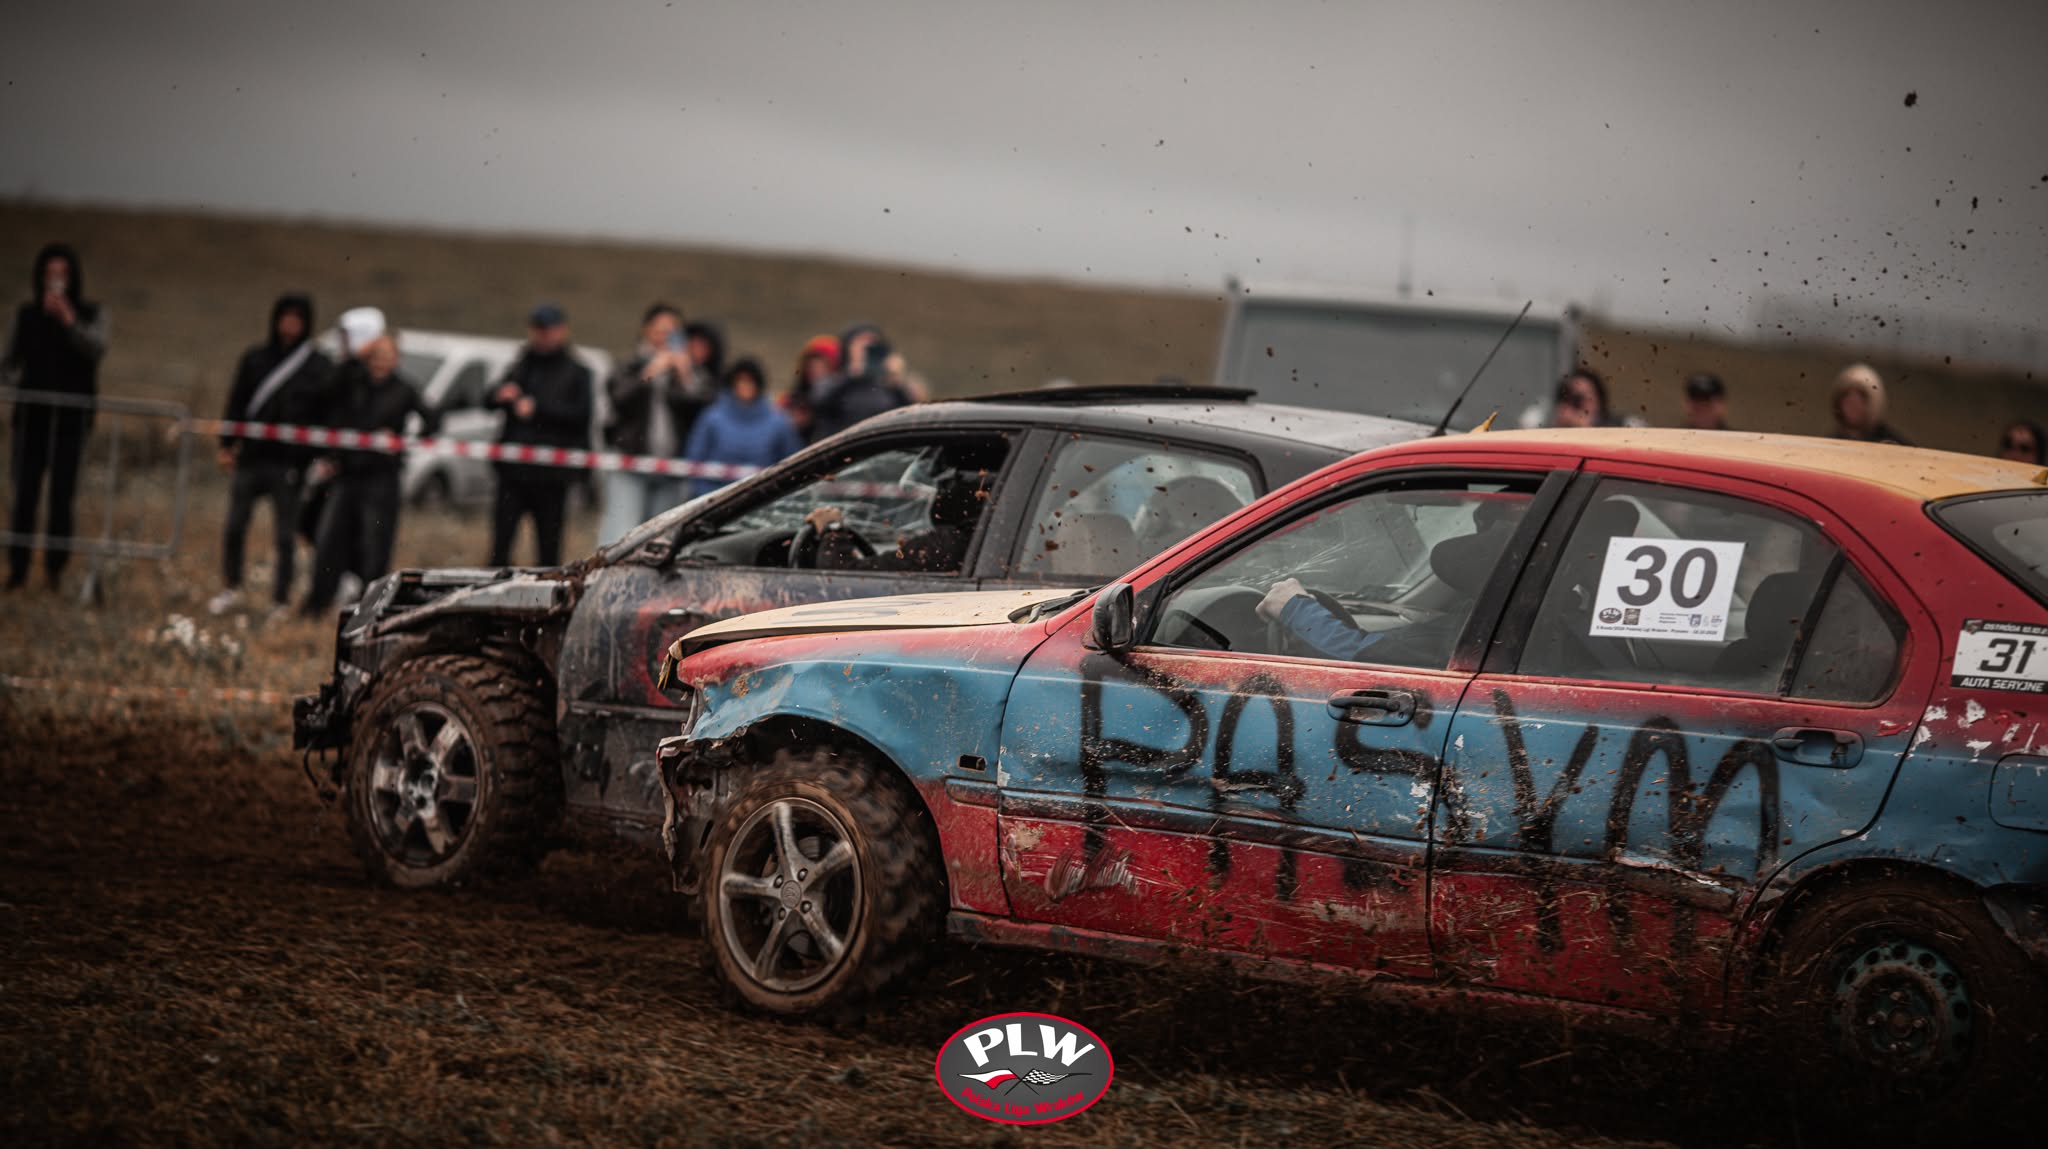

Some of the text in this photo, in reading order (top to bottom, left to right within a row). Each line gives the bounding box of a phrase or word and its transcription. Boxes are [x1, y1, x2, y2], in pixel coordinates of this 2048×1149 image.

[1617, 545, 1718, 609] 30
[1978, 638, 2037, 675] 31
[1960, 677, 2046, 693] AUTA SERYJNE
[1079, 652, 1781, 952] PASYM
